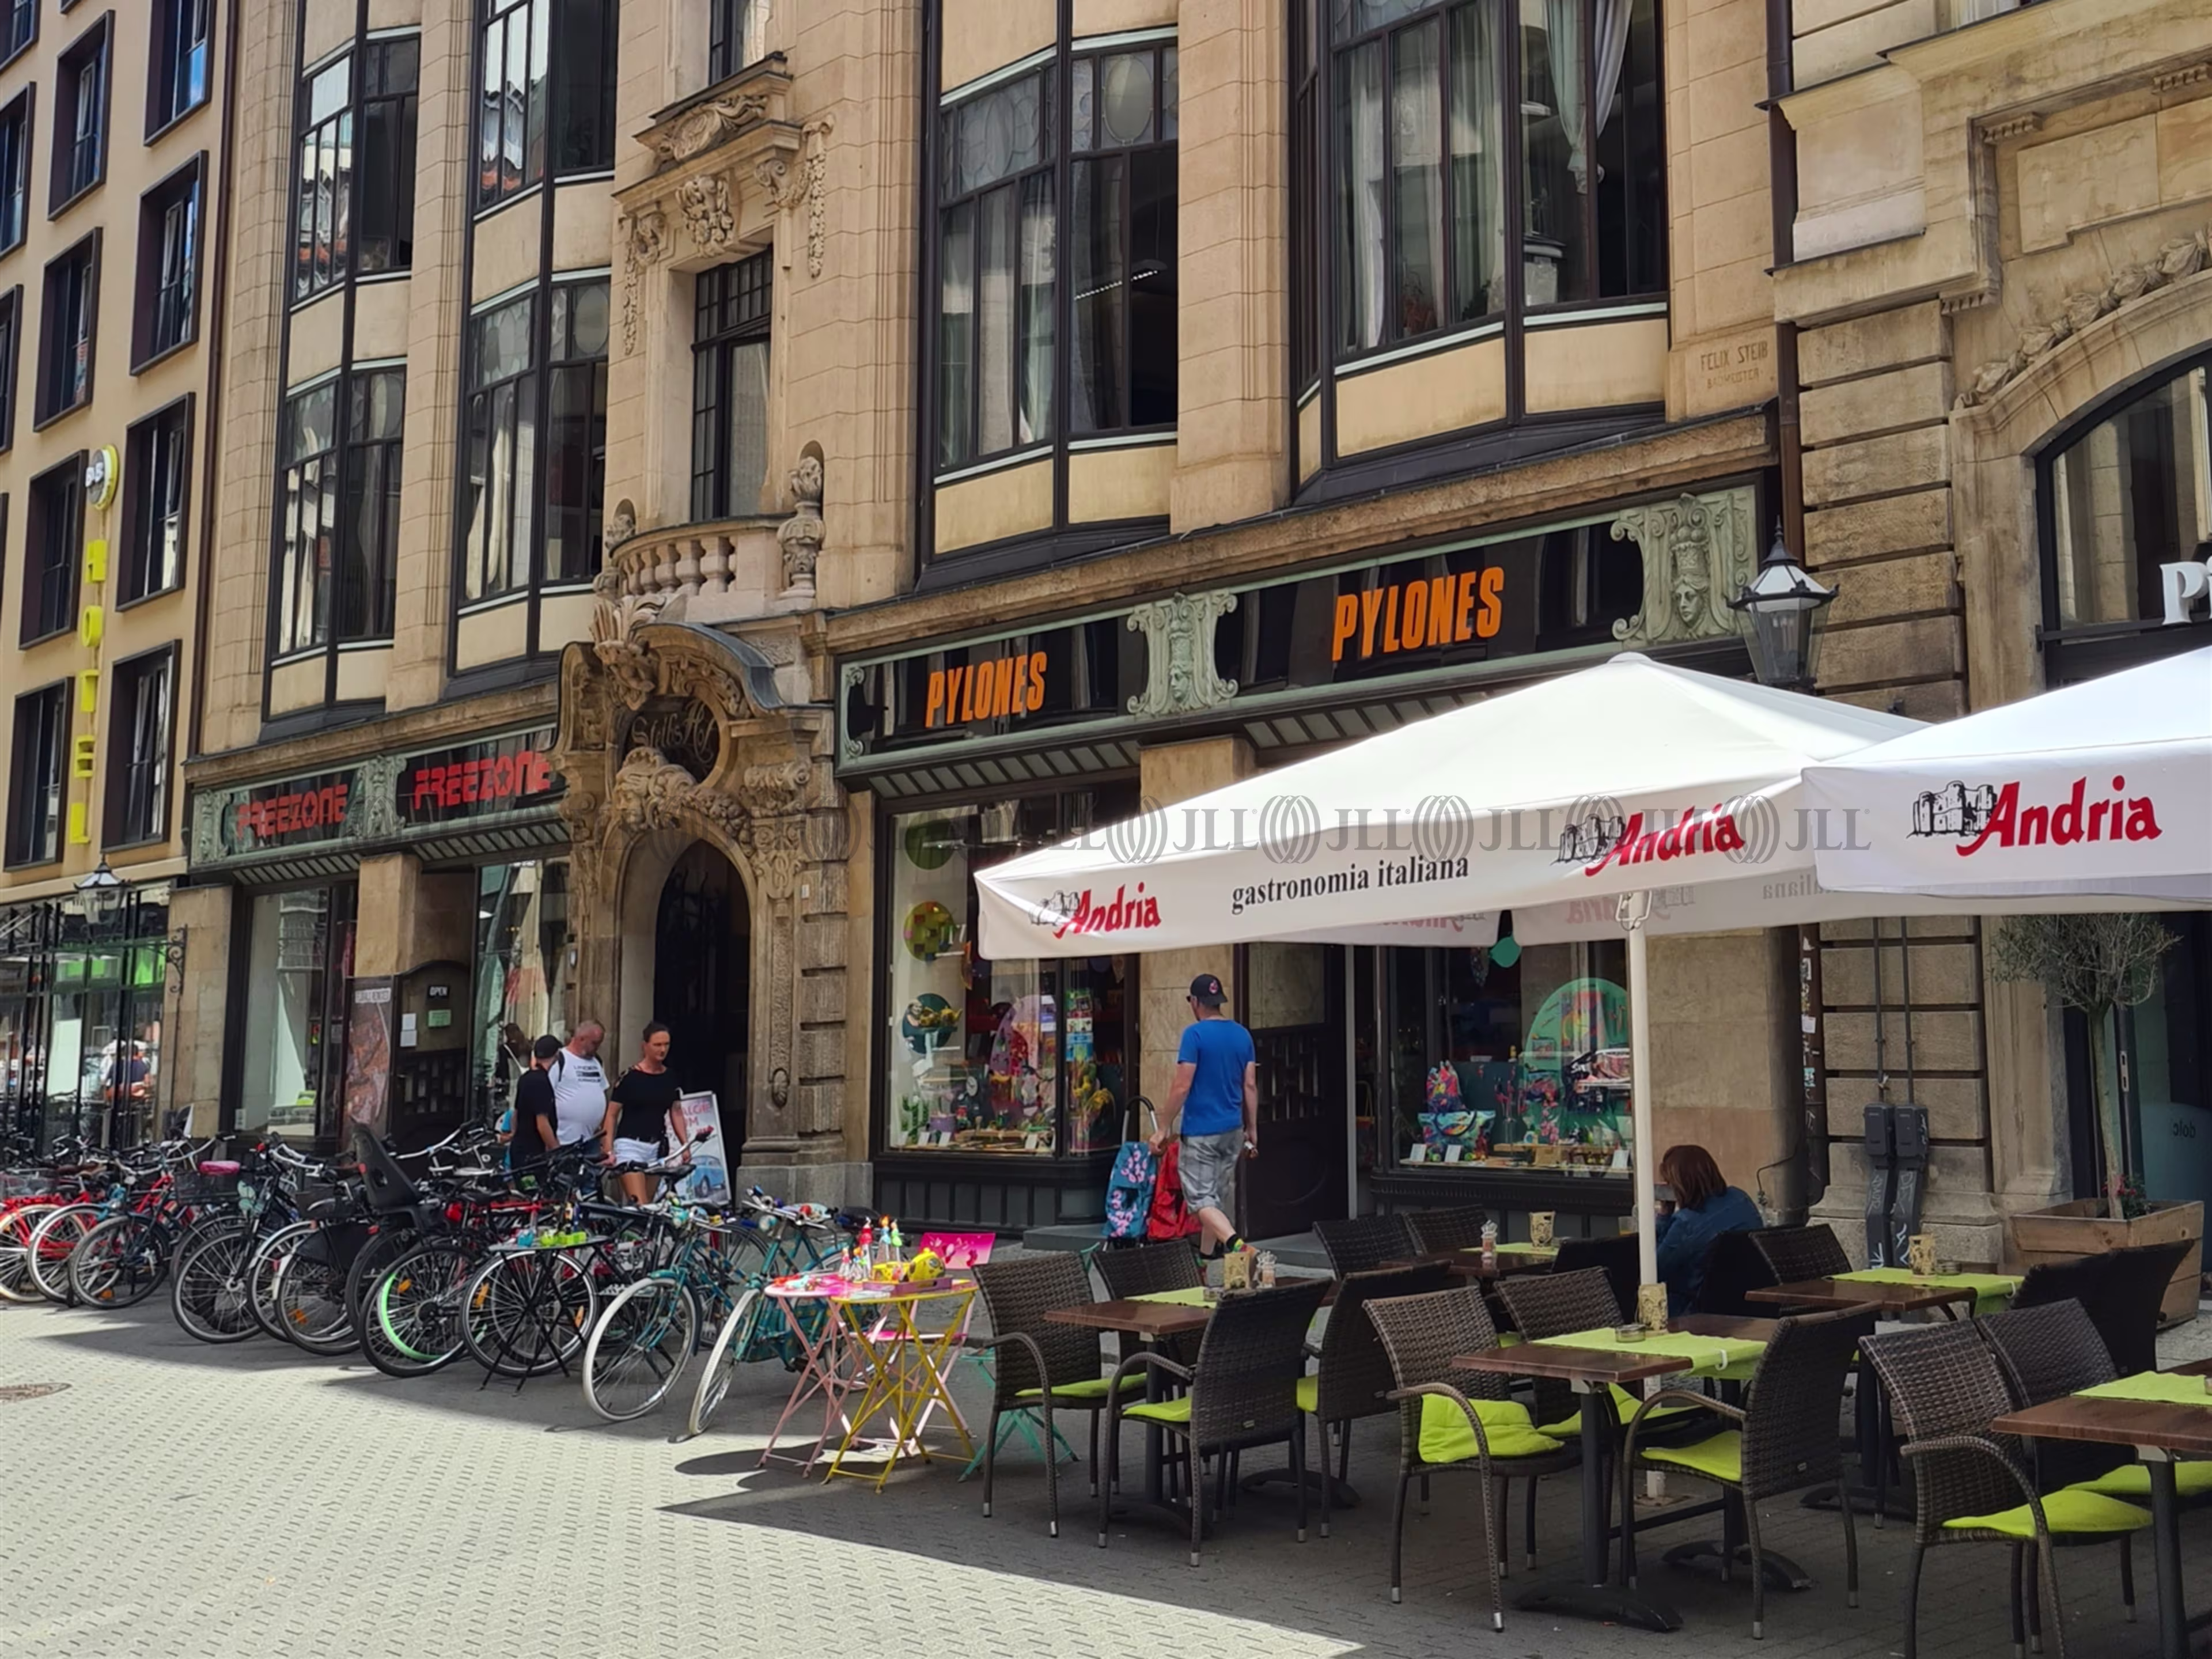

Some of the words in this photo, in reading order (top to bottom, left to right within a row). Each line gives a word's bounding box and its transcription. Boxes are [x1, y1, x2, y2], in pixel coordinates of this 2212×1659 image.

[1700, 349, 1730, 372] FELIX
[1737, 340, 1768, 364] STEIB
[1332, 566, 1504, 662] PYLONES
[69, 539, 107, 844] HOTEL
[925, 652, 1047, 727] PYLONES
[415, 751, 551, 810] FREEZONE
[237, 783, 348, 840] FREEZONE
[1585, 803, 1745, 877] Andria
[1956, 775, 2162, 857] Andria
[1052, 881, 1161, 939] Andria
[1232, 863, 1369, 915] gastronomia
[1377, 855, 1469, 888] italiana
[430, 986, 448, 997] OPEN
